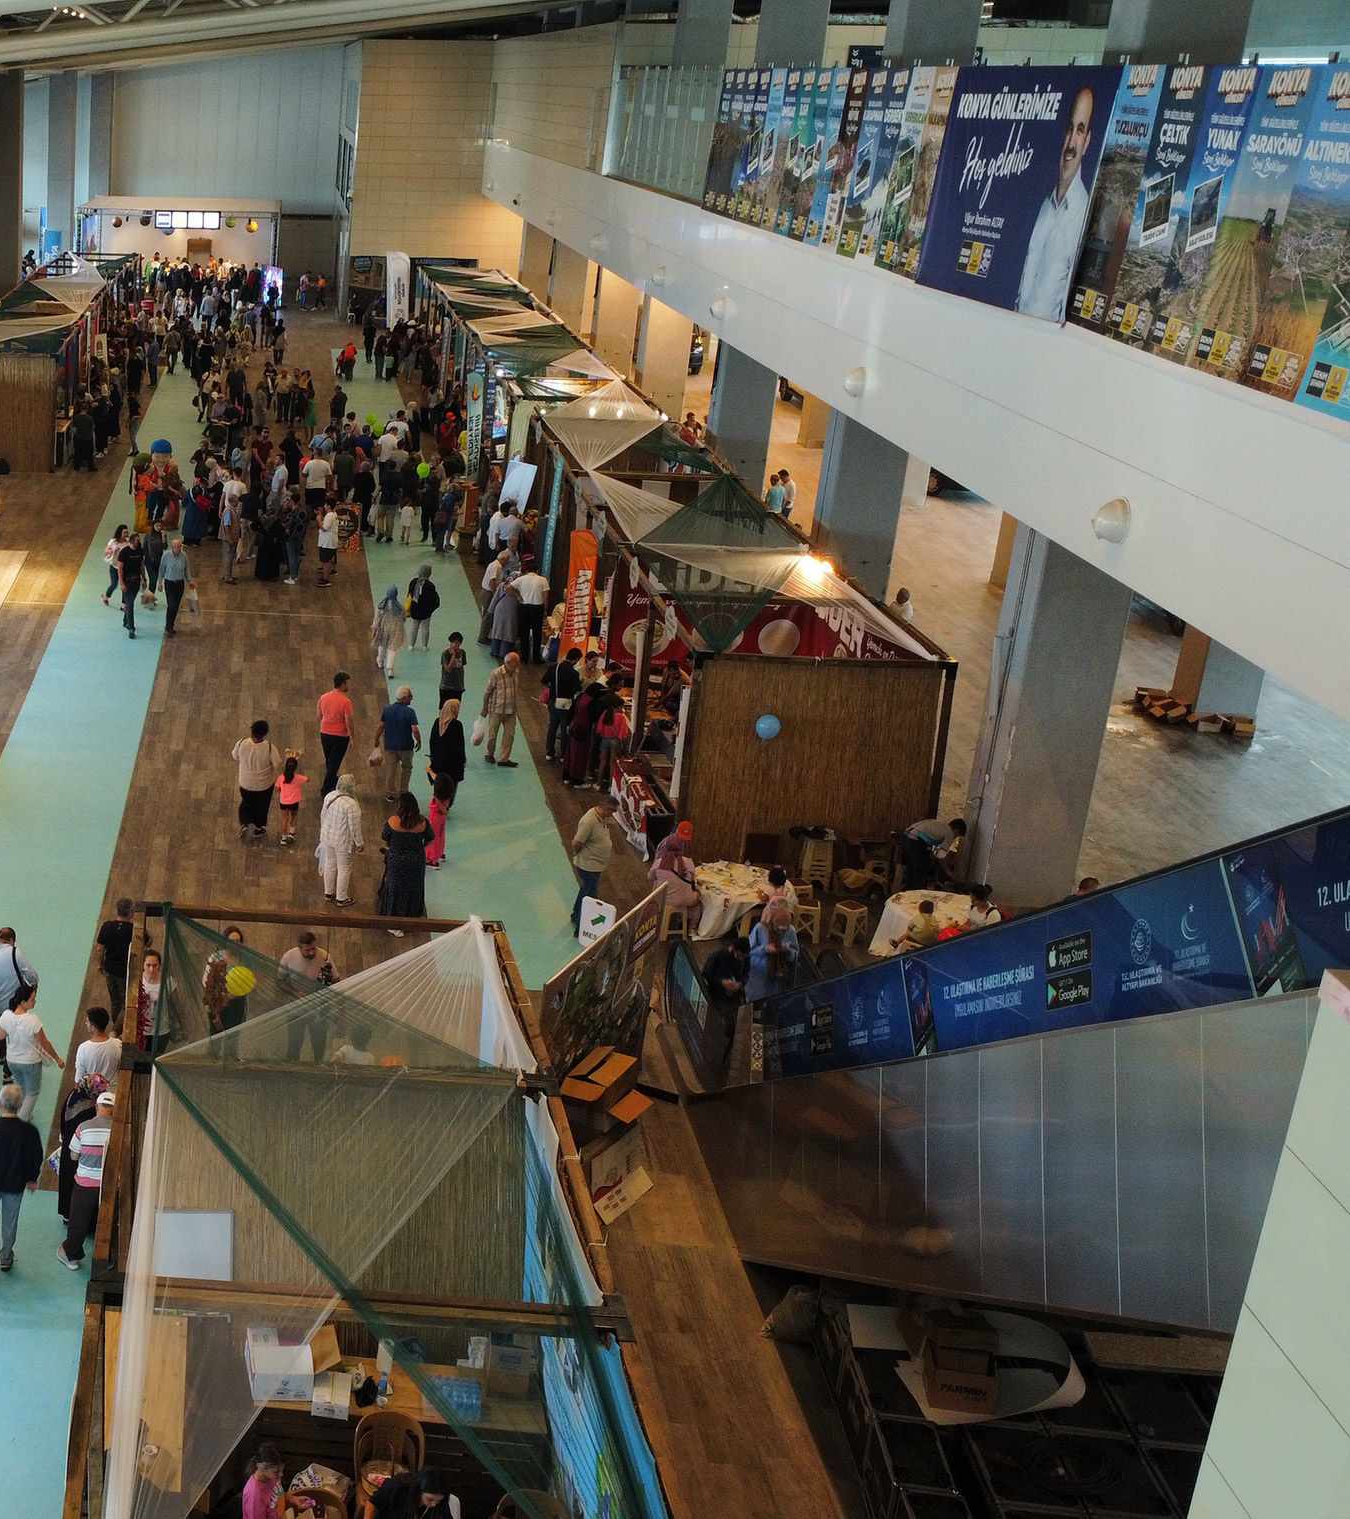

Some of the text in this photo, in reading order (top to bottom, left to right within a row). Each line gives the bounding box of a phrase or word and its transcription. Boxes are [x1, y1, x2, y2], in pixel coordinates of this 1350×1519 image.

[1128, 64, 1159, 89] KONYA
[1170, 66, 1204, 90] KONYA
[1218, 68, 1258, 94] KONYA
[1268, 68, 1312, 98] KONYA
[957, 84, 1062, 120] KONYA GÜNLERİMİZE
[1115, 120, 1149, 141] TUZLUKÇU
[1160, 123, 1190, 148] ÇELTİK
[1208, 128, 1241, 151] YUNAK
[1246, 132, 1303, 156] SARAYÖNÜ
[959, 122, 1033, 209] Hoş geldiniz
[1317, 886, 1331, 907] 12.
[583, 930, 600, 940] MES
[1058, 948, 1087, 967] App Store
[950, 979, 976, 999] ULAŞTIRMA
[976, 978, 982, 992] VE
[983, 970, 1014, 991] HABERLEŞME
[1059, 985, 1089, 1002] Google Play
